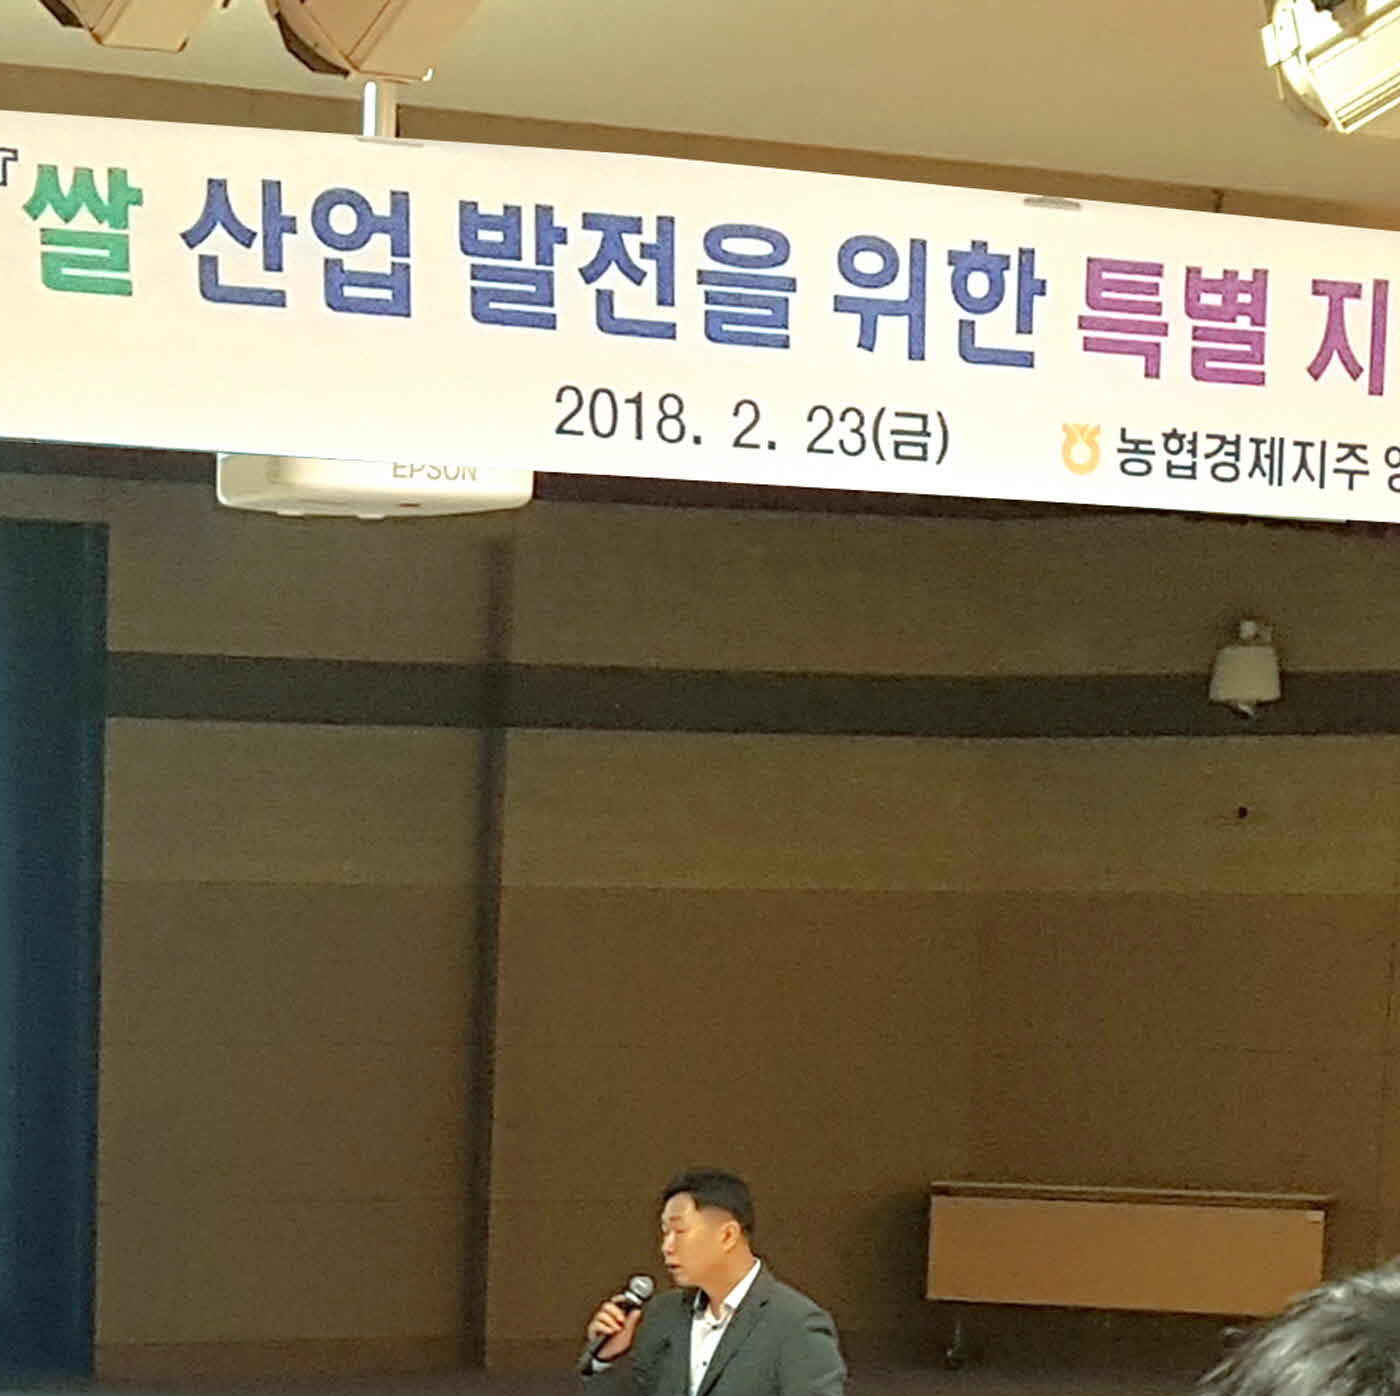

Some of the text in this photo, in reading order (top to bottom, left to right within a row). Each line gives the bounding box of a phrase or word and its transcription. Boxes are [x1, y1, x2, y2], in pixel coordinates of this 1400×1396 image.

[180, 176, 414, 319] 산업
[457, 199, 798, 351] 발전을
[832, 232, 1047, 369] 위한
[1076, 255, 1271, 388] 특별
[553, 385, 951, 466] 2018. 2. 23(금)
[1116, 427, 1371, 491] 농협경제지주
